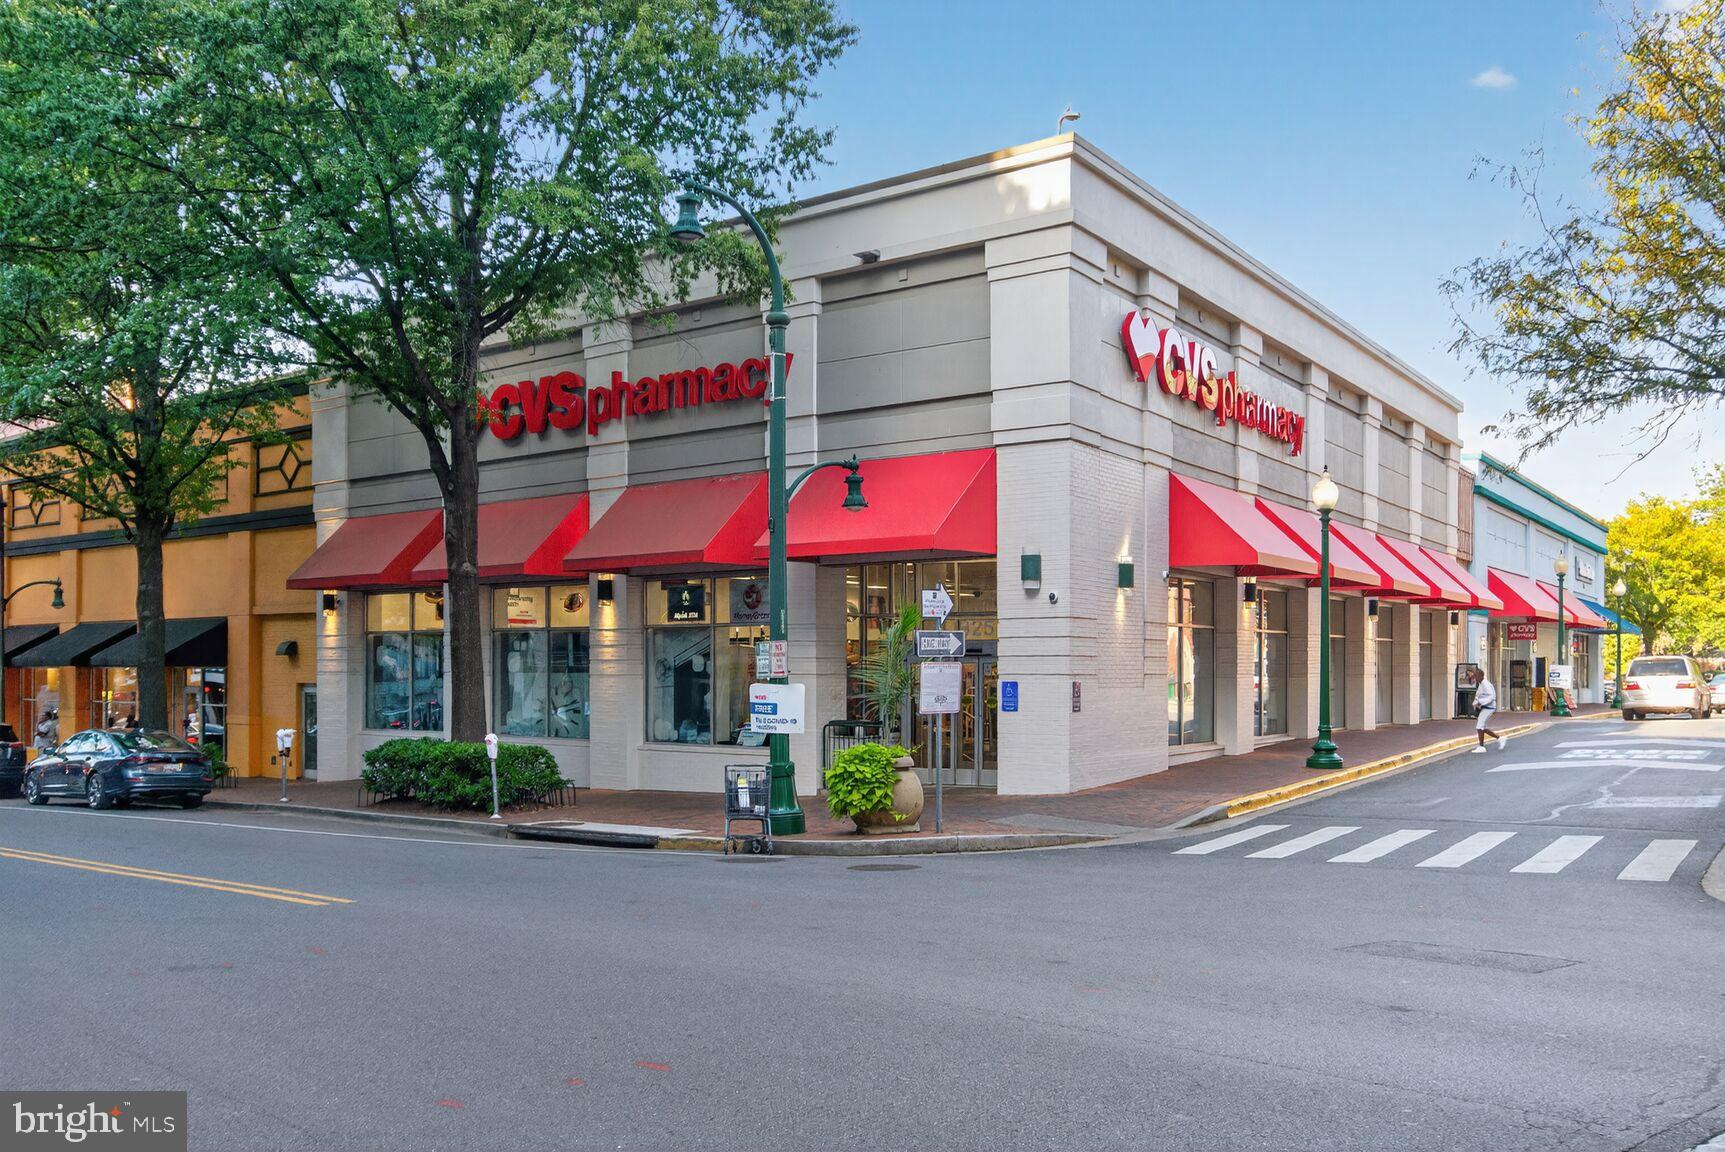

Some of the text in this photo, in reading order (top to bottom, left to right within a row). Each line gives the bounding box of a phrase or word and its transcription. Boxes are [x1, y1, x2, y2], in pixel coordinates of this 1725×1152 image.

[488, 371, 586, 440] CVS
[1156, 328, 1305, 457] CVS pharmacy
[1518, 624, 1536, 632] CVS
